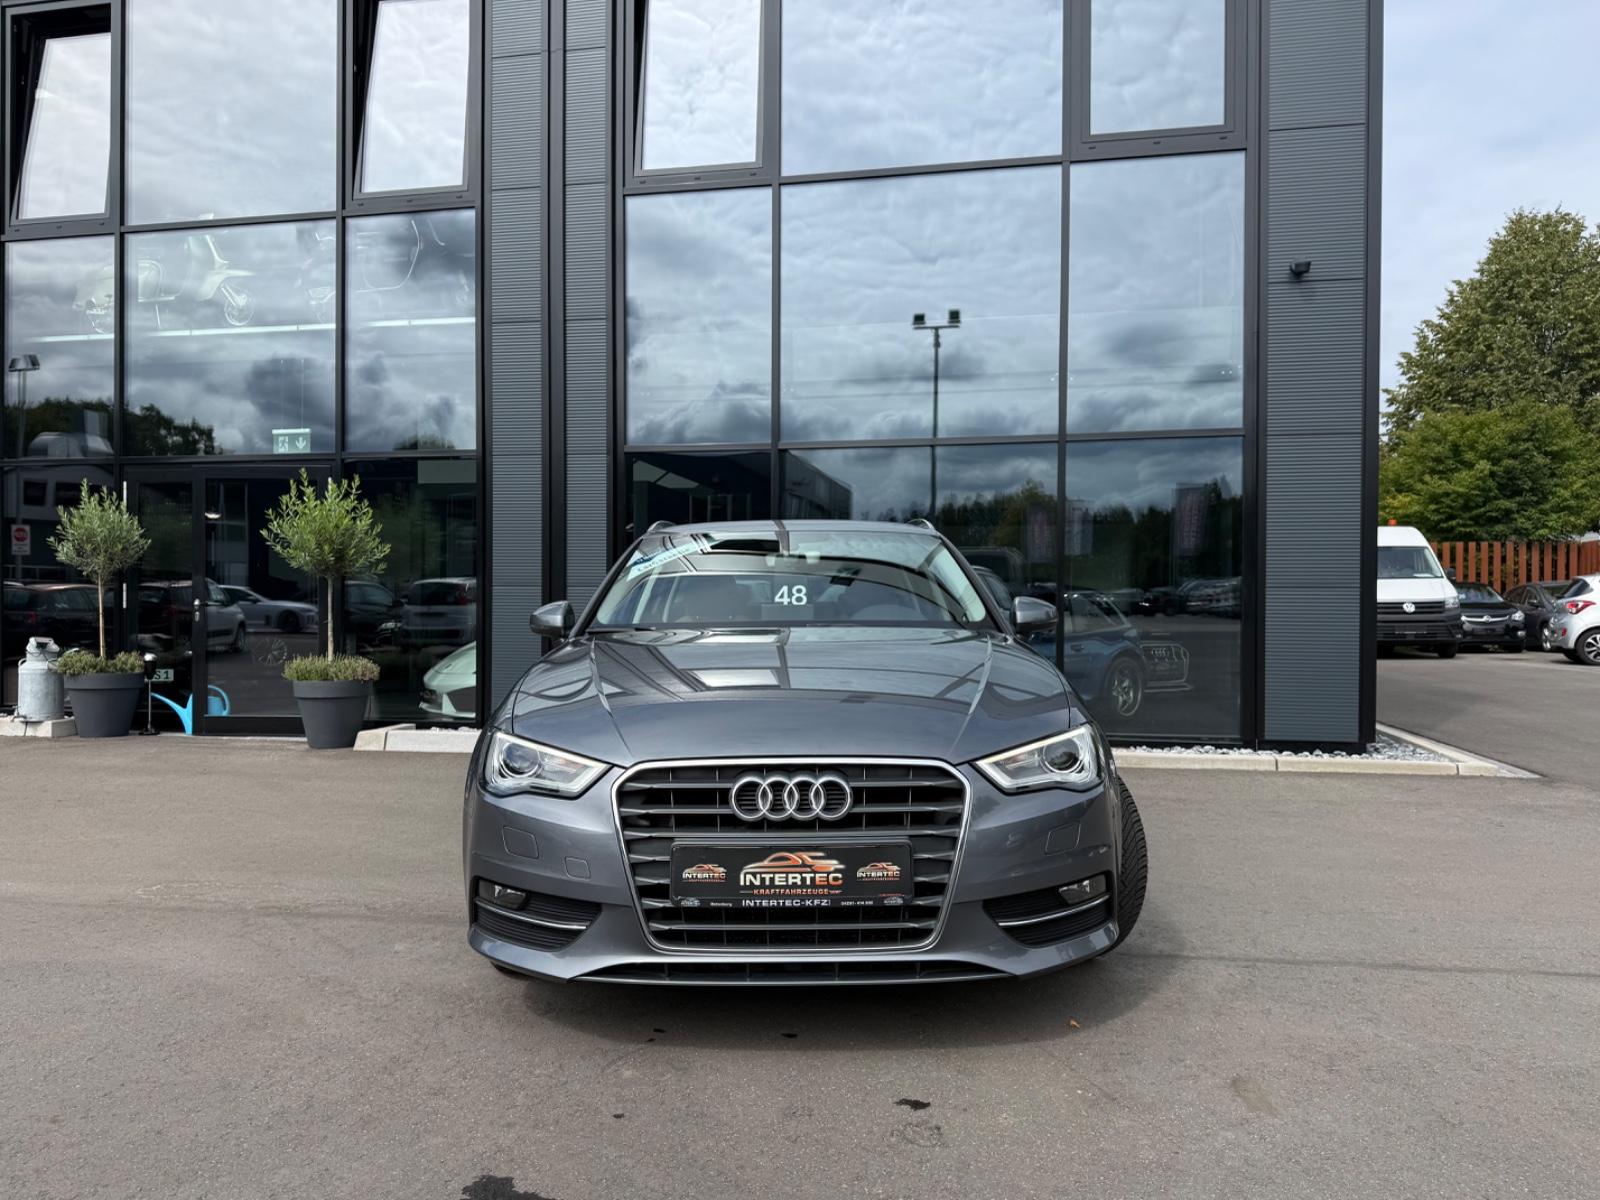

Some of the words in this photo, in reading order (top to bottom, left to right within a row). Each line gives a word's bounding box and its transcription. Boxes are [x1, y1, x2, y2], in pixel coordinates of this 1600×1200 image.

[774, 585, 807, 605] 48
[740, 873, 843, 886] INTERTEC
[742, 899, 828, 907] INTERTEC-KFZ
